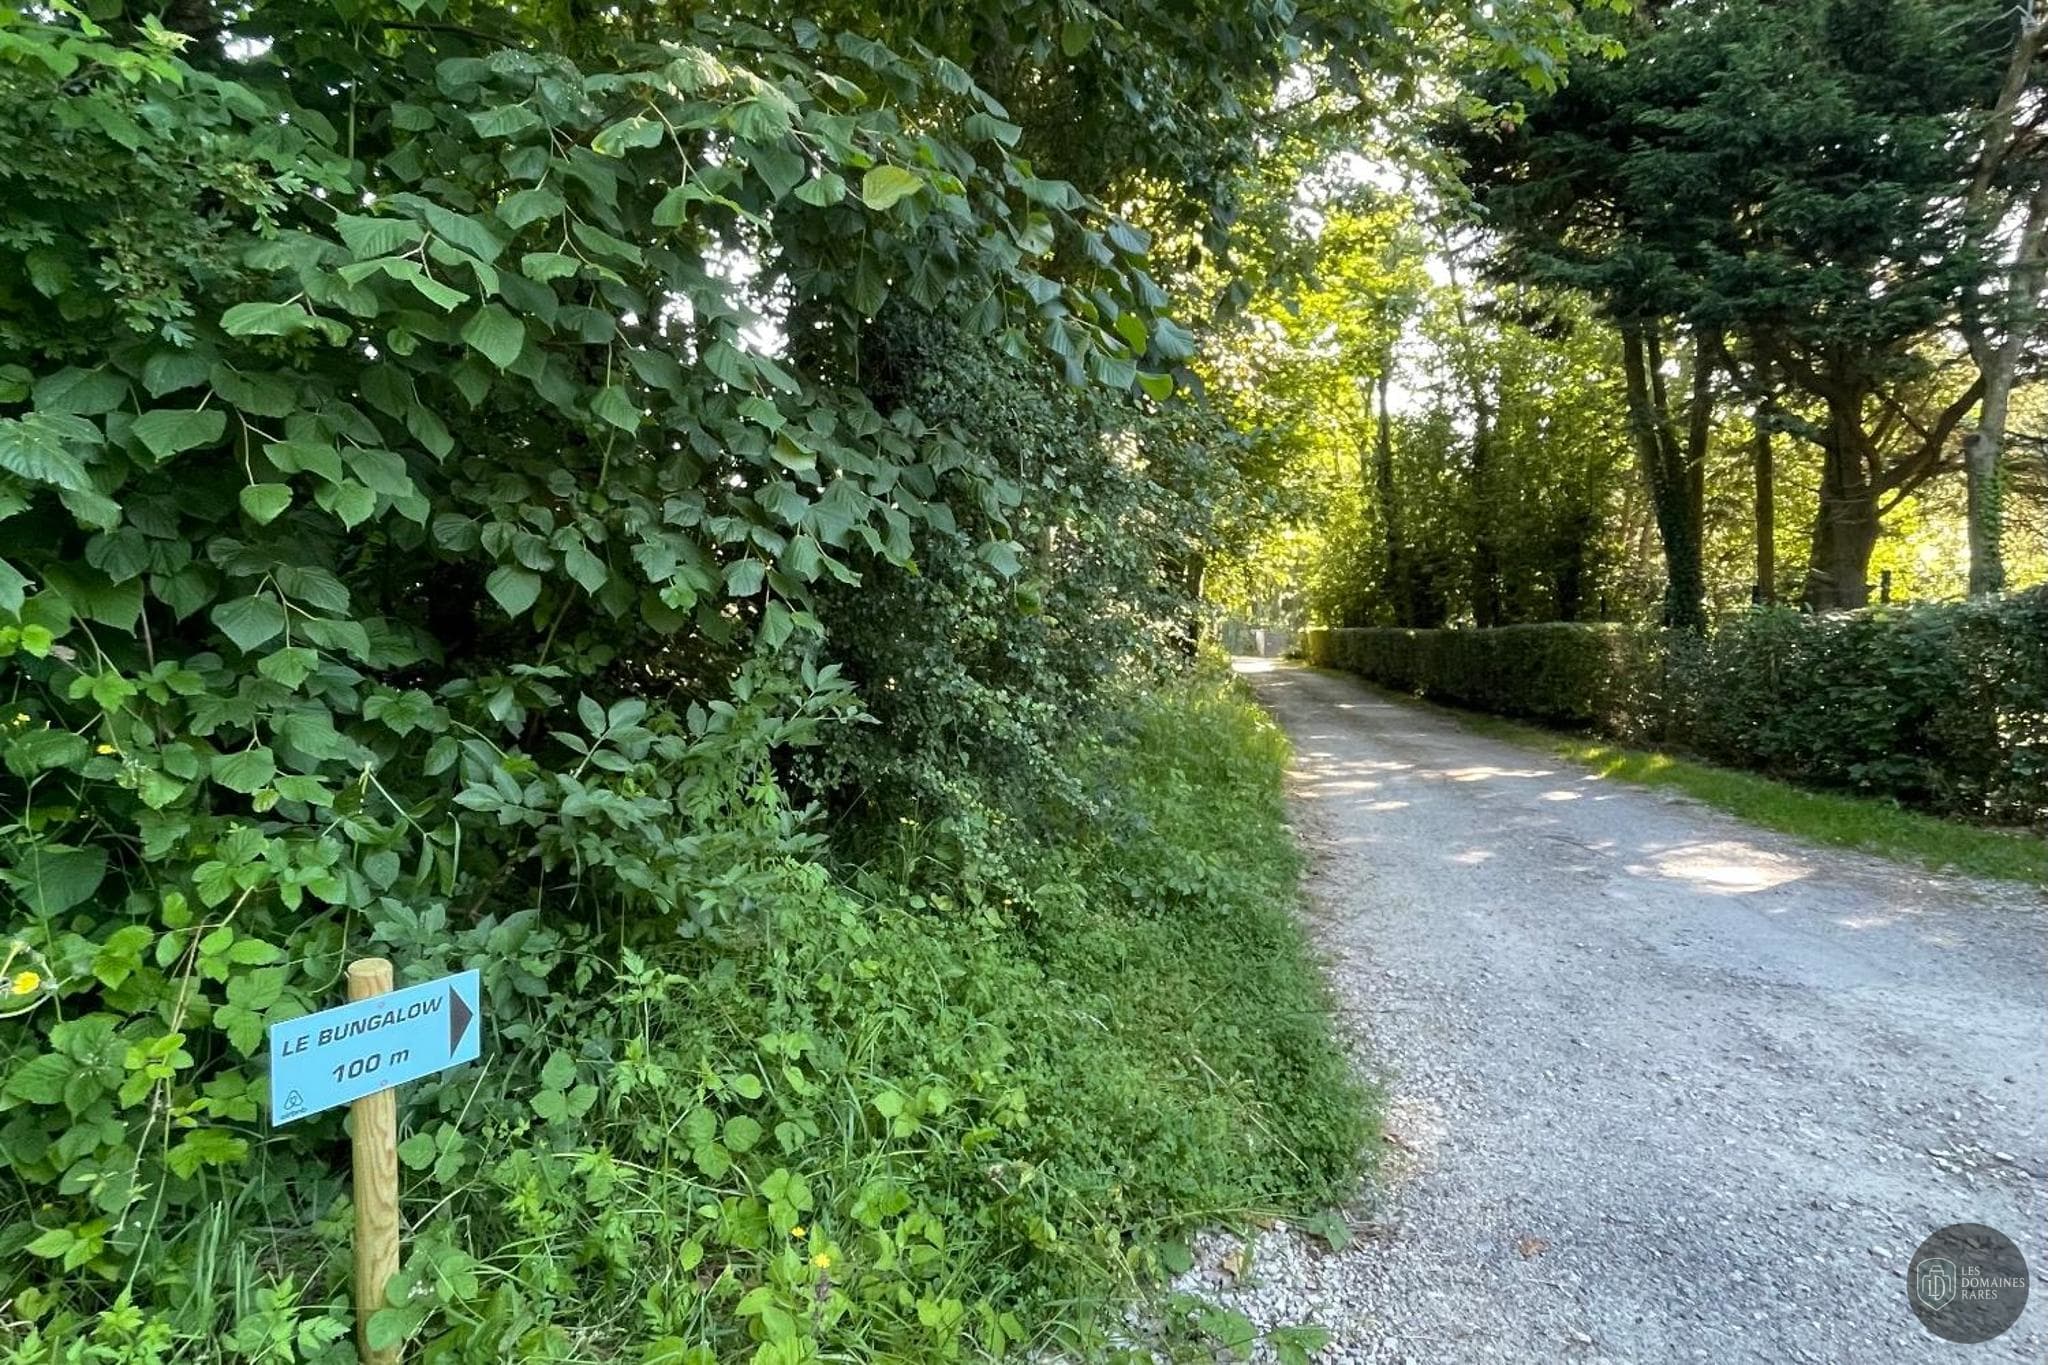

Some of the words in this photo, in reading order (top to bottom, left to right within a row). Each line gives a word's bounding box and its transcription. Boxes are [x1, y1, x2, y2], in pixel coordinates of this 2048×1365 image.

[282, 1035, 309, 1057] LE
[318, 997, 443, 1047] BUNGALOW
[332, 1053, 381, 1083] 100
[389, 1049, 409, 1066] m
